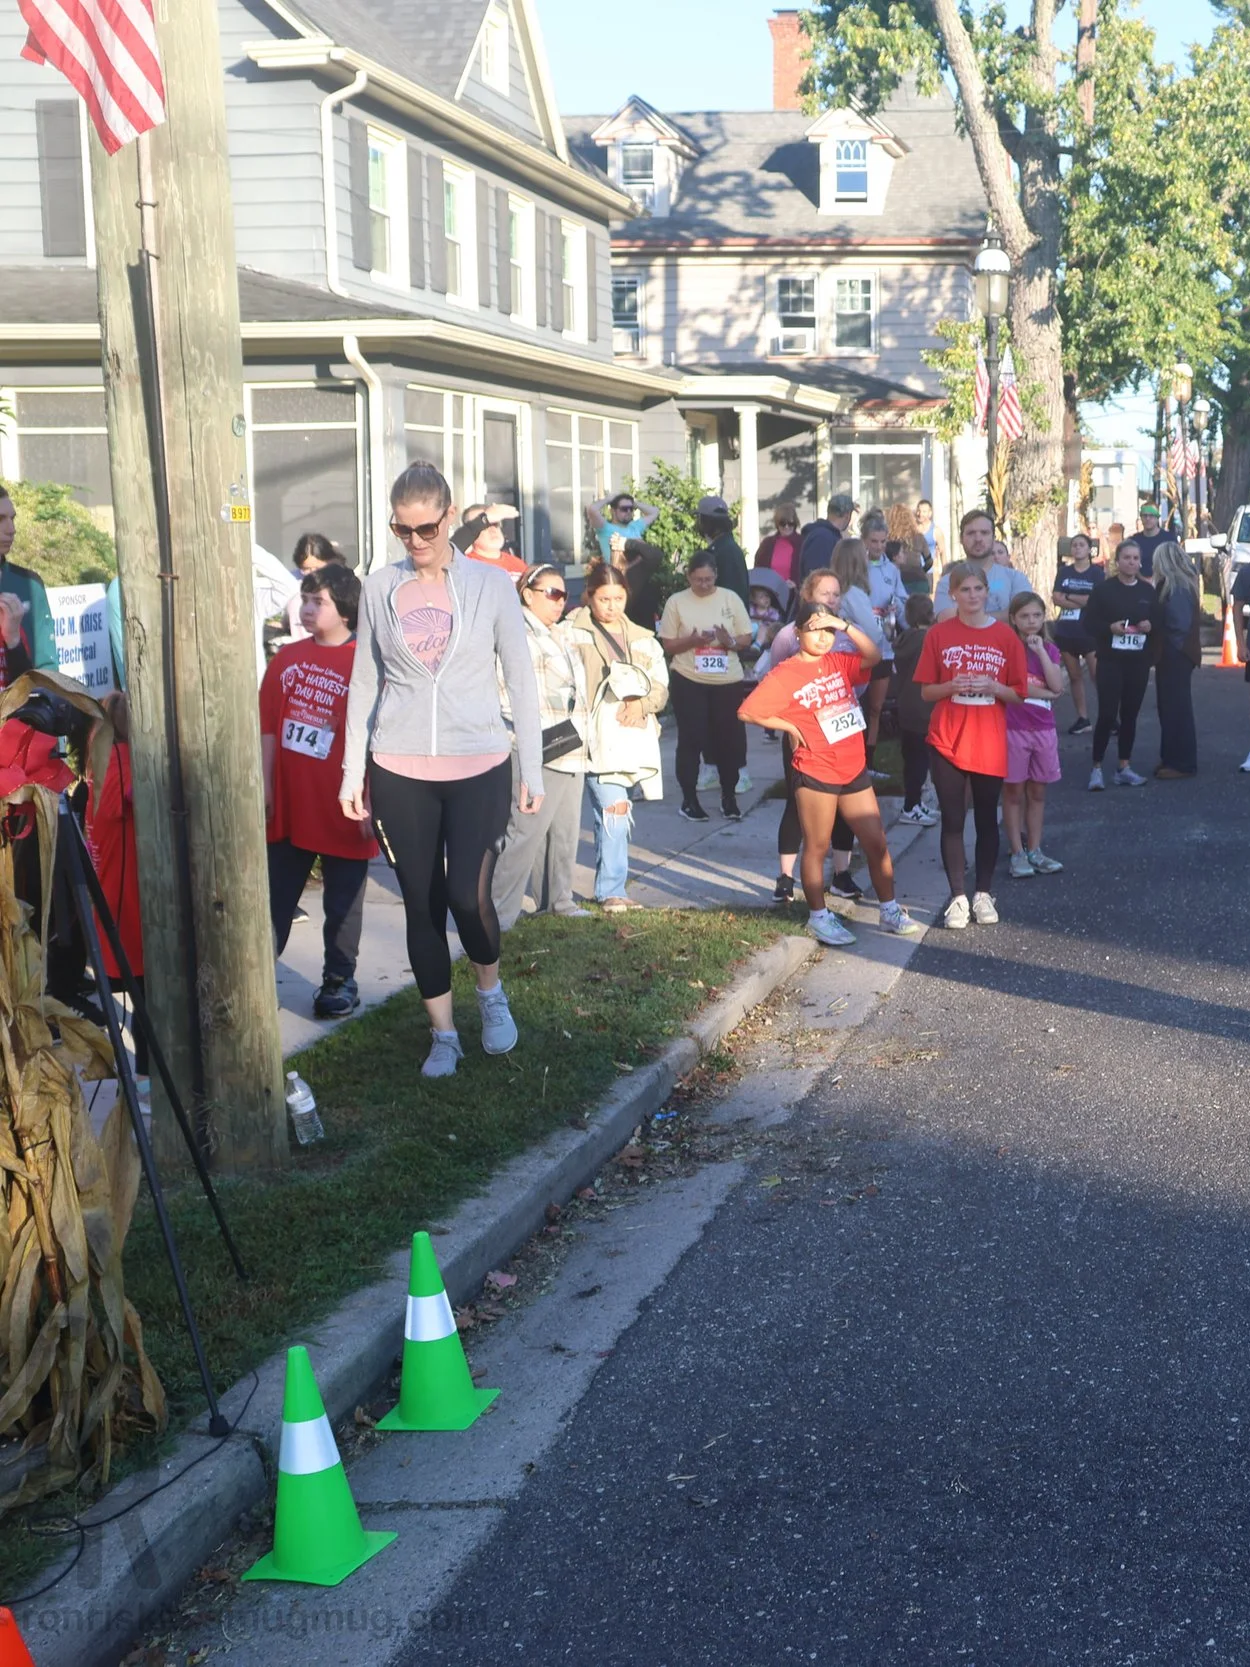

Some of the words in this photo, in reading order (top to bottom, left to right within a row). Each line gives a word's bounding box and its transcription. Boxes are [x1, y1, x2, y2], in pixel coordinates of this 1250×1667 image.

[58, 595, 87, 606] SPONSOR
[68, 615, 77, 634] M.
[80, 612, 103, 634] KRISE
[1120, 636, 1139, 645] 316
[702, 657, 724, 669] 328
[974, 651, 1006, 668] HARVEST
[96, 666, 109, 686] LLC
[304, 673, 350, 697] HARVEST
[294, 683, 314, 700] DAY
[313, 690, 336, 707] RUN
[831, 712, 857, 733] 252
[286, 722, 319, 747] 314
